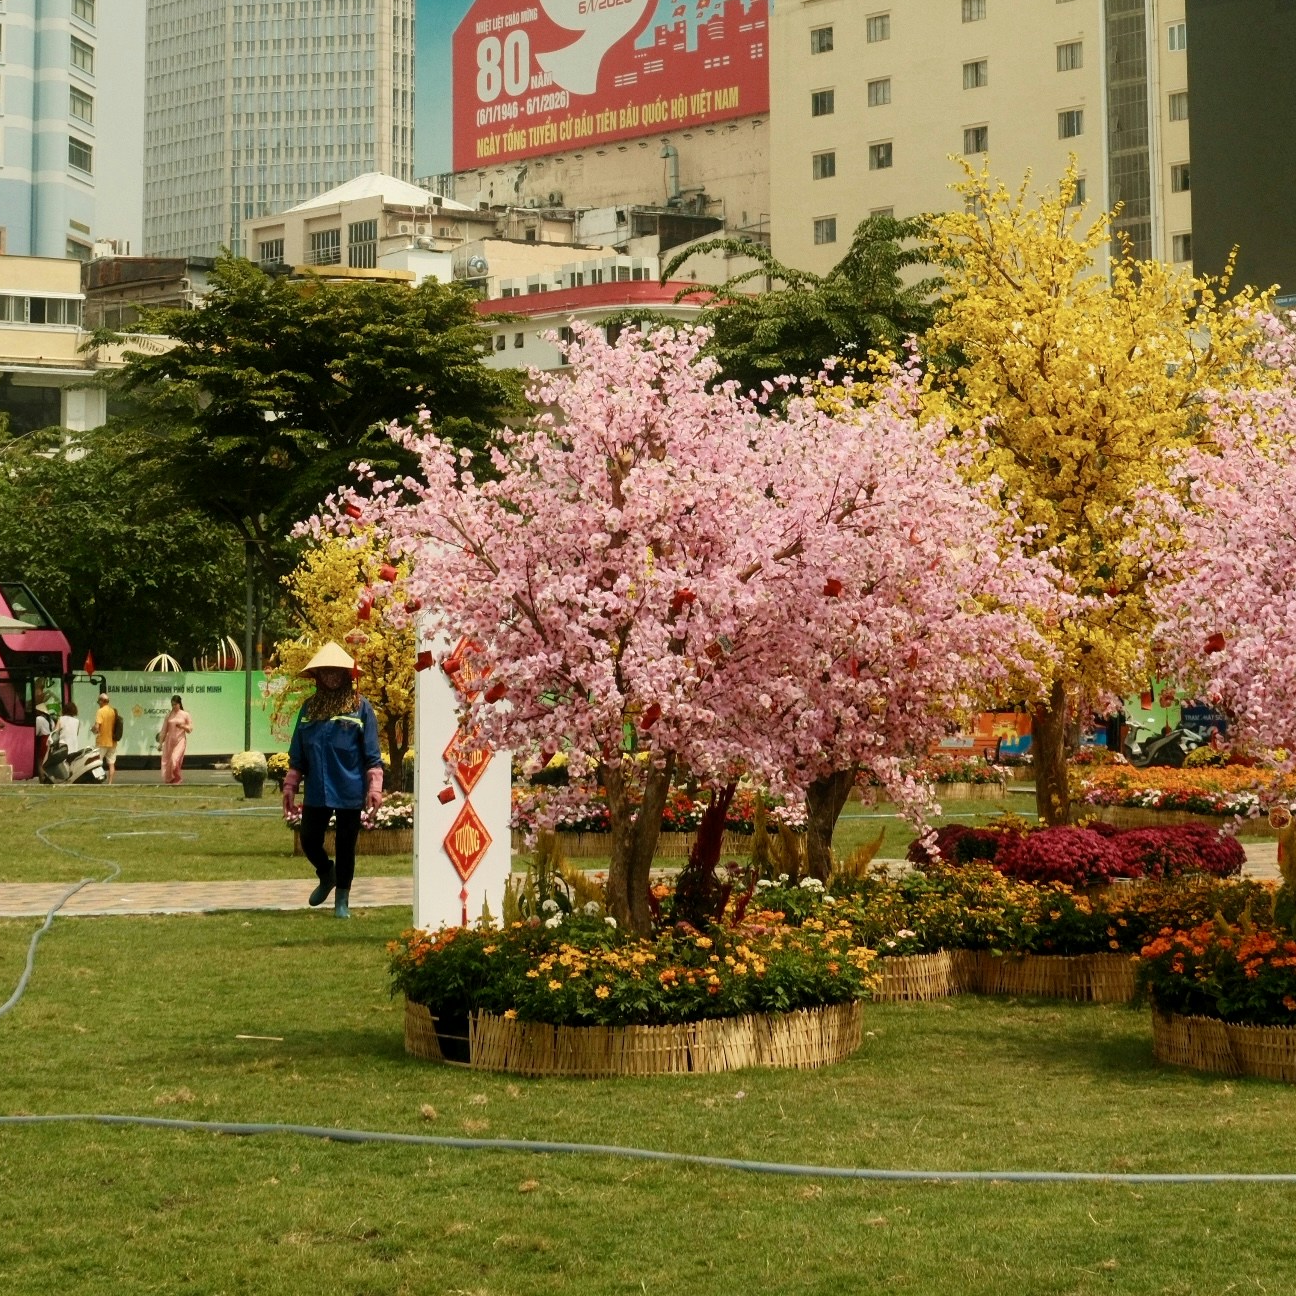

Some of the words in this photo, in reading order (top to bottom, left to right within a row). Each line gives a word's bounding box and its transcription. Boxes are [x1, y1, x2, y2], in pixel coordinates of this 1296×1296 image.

[492, 14, 505, 32] LIỆT
[477, 29, 530, 103] 80
[531, 71, 553, 90] NĂM
[527, 91, 570, 116] 6/1/2026)
[477, 132, 501, 158] NGÀY
[503, 124, 527, 153] TỔNG
[529, 116, 558, 147] TUYỂN
[560, 113, 573, 141] CỬ
[574, 109, 594, 138] ĐẦU
[596, 107, 617, 134] TIÊN
[619, 100, 639, 130] BẦU
[642, 94, 669, 126] QUỐC
[671, 93, 688, 123] HỘI
[690, 88, 713, 118] VIỆT
[714, 86, 739, 111] NAM
[206, 685, 222, 693] MINH
[455, 823, 481, 857] VƯỢNG
